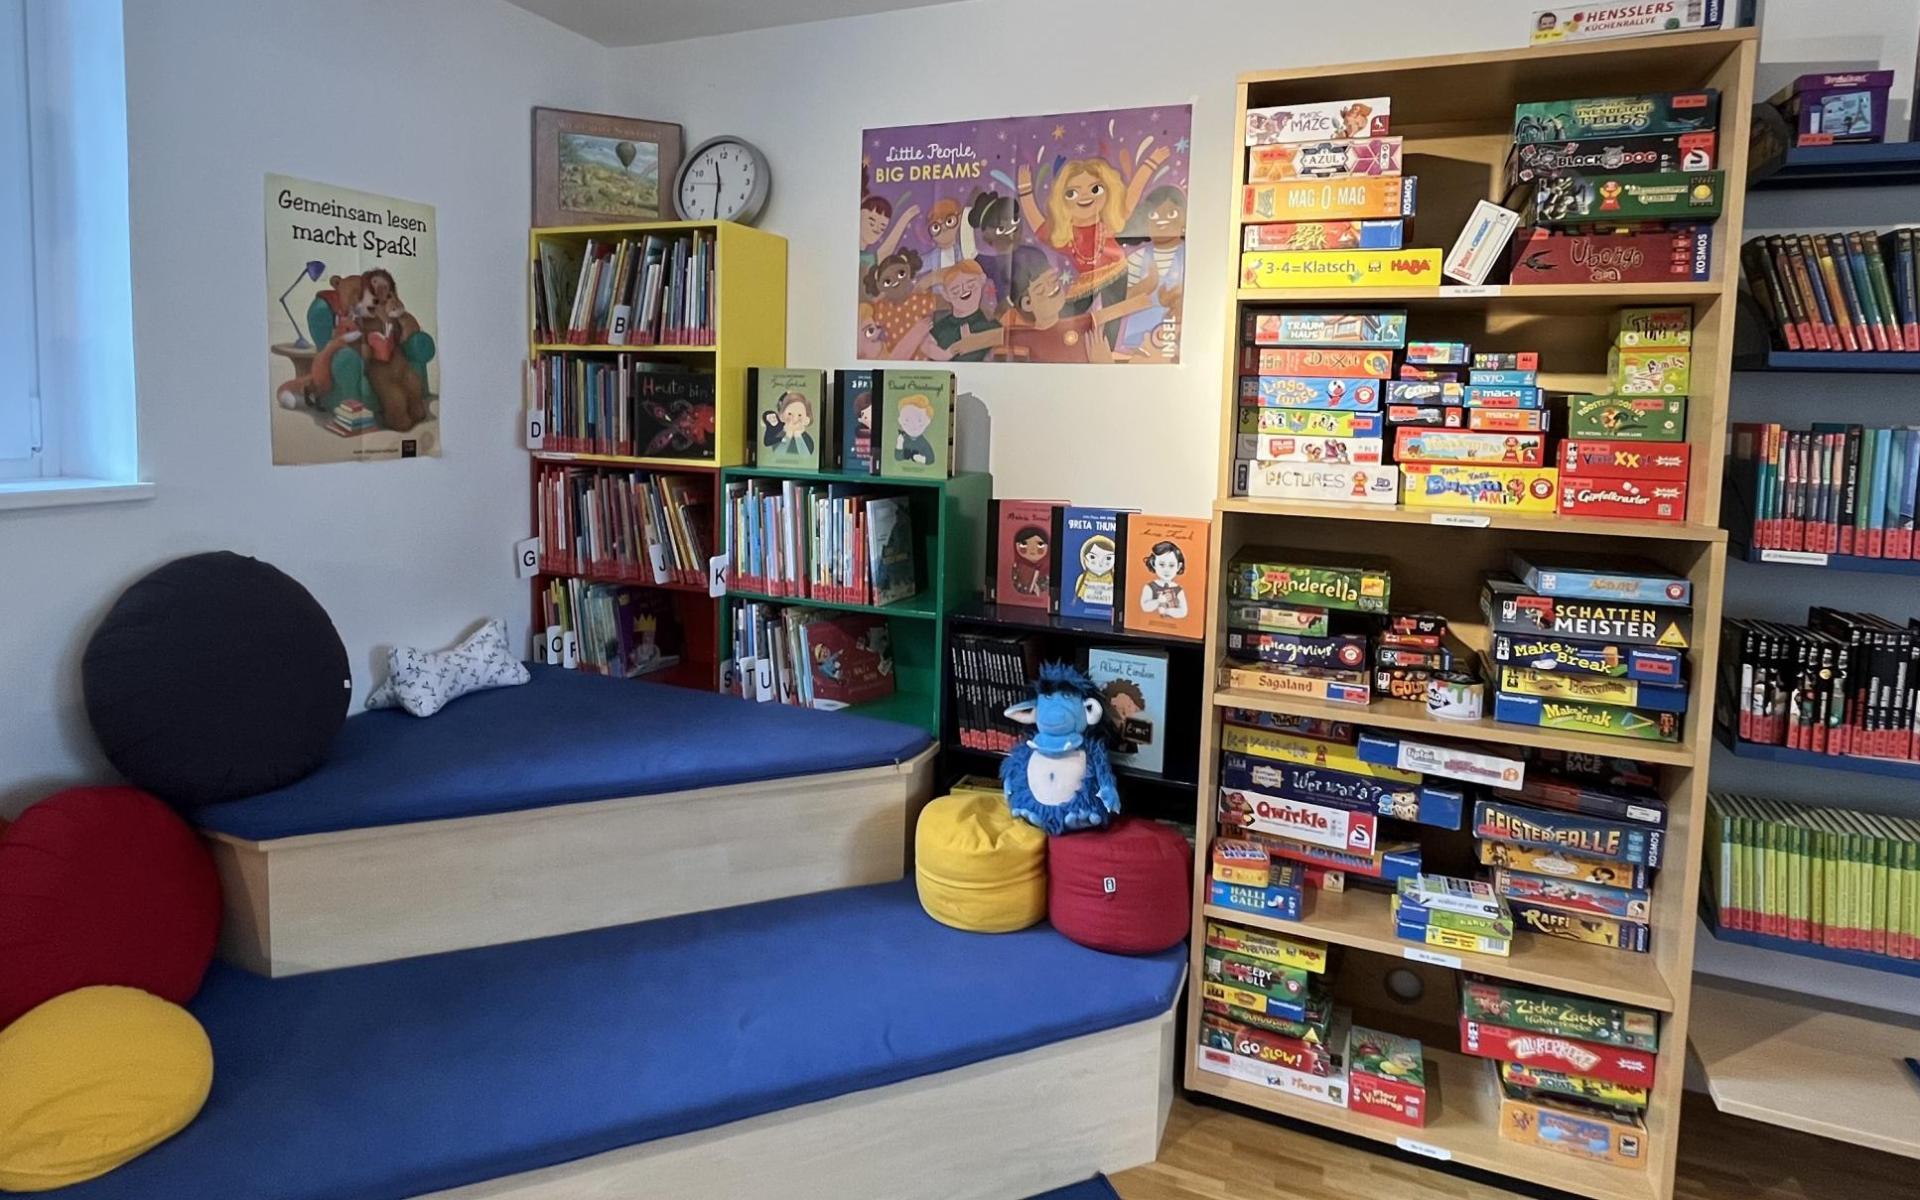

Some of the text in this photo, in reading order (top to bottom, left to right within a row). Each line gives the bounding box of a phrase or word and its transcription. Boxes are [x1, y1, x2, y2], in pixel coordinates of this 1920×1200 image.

[1586, 1, 1674, 22] HENSSLERS
[1584, 16, 1656, 33] KÜCHENRALLYE
[1291, 117, 1330, 132] MAZE
[886, 142, 977, 165] Little People,
[1309, 154, 1339, 165] AZUL
[1556, 151, 1658, 168] BLACK DOG
[875, 162, 980, 183] BIG DREAMS
[278, 189, 427, 233] Gemeinsam lesen
[292, 223, 417, 257] macht Spaß!
[1695, 233, 1708, 274] KOSMOS
[1391, 260, 1432, 276] HABA
[614, 316, 625, 333] B
[1286, 320, 1326, 332] TRAUM
[1161, 315, 1177, 358] INSEL
[643, 378, 684, 396] Heute
[531, 422, 541, 437] D
[1265, 472, 1346, 488] PICTURES
[1068, 518, 1092, 531] GRETA
[523, 551, 536, 568] G
[658, 554, 666, 572] J
[715, 569, 725, 586] K
[1555, 605, 1656, 623] SCHATTEN
[1554, 618, 1656, 639] MEISTER
[551, 636, 562, 652] O
[1514, 641, 1561, 657] Make
[1556, 652, 1612, 674] Break
[724, 671, 732, 688] S
[746, 668, 755, 686] T
[761, 670, 772, 690] U
[1258, 675, 1313, 693] Sagaland
[1543, 703, 1577, 719] Make
[1291, 769, 1322, 791] Wer
[1256, 801, 1328, 830] Qwirkle
[1648, 831, 1660, 868] KOSMOS
[1230, 886, 1266, 900] HALLI
[1230, 895, 1265, 909] GALLI
[1514, 999, 1608, 1027] Zicke Zacke
[1239, 1040, 1303, 1068] GO SLOW!
